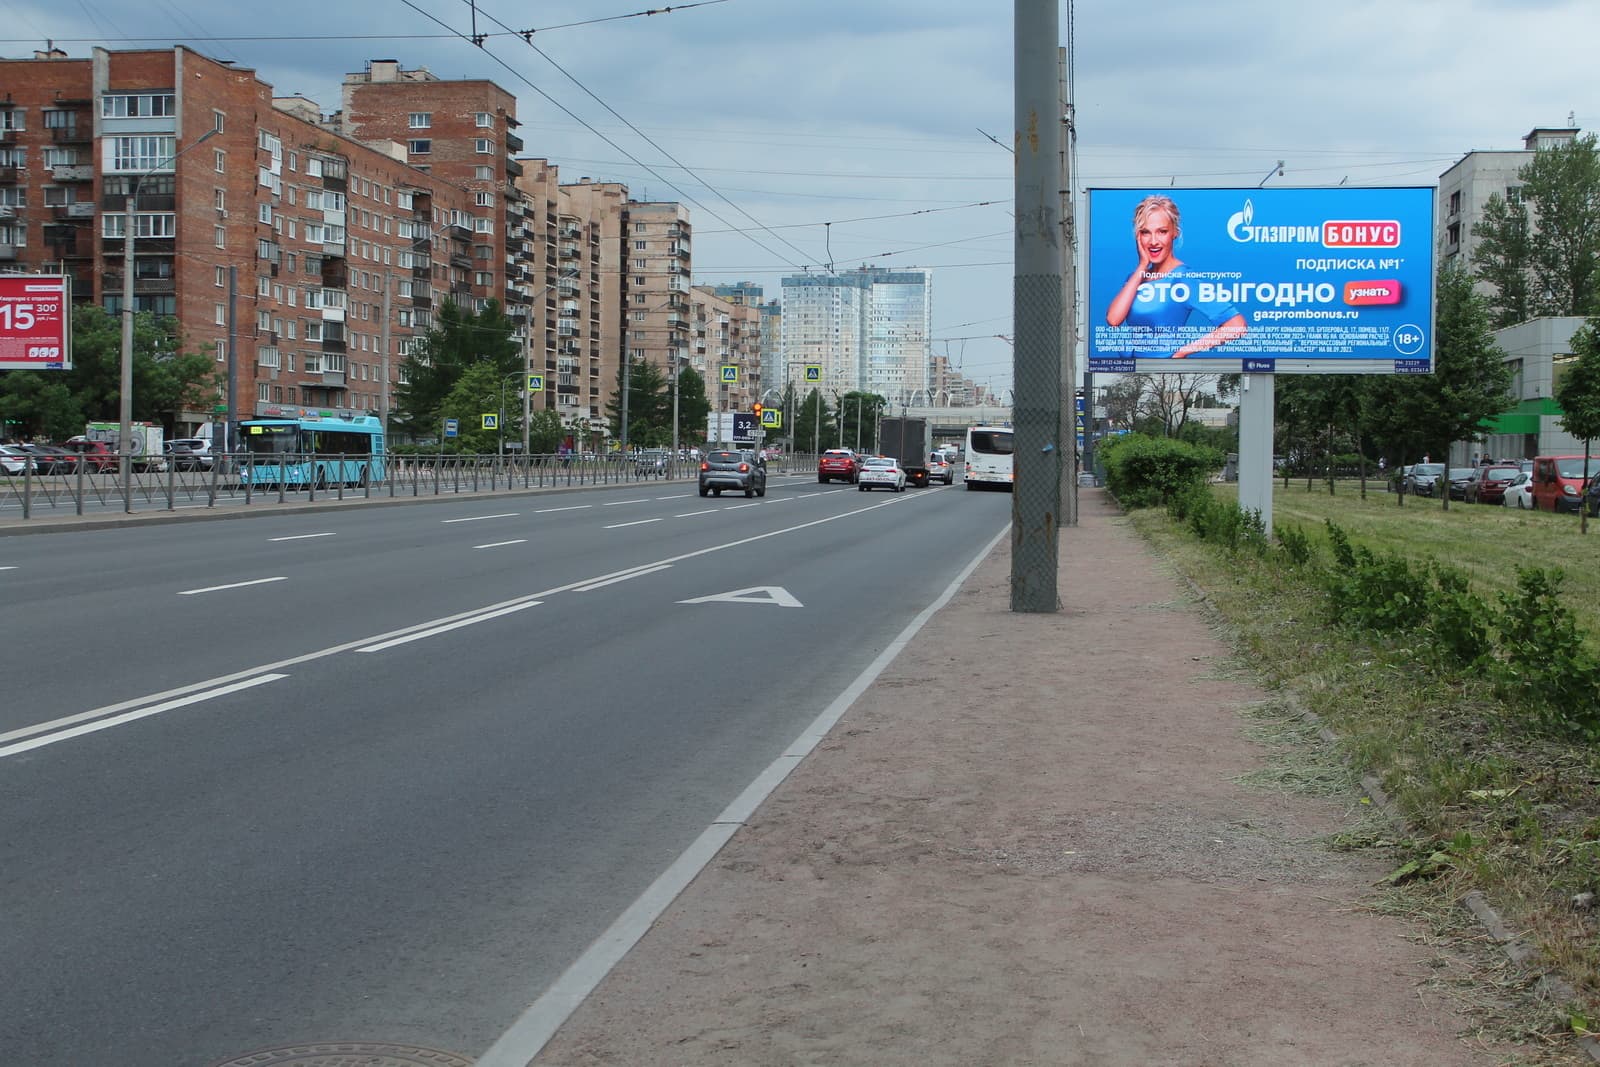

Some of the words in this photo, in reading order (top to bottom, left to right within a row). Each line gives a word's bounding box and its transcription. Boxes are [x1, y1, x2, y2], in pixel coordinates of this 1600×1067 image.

[1255, 226, 1319, 243] ГАЗПРОМ
[1327, 226, 1394, 243] БОНУС
[1296, 259, 1375, 272] ПОДПИСКА
[1139, 271, 1242, 280] Подписка-конструктор
[1137, 283, 1190, 302] ЭТО
[1198, 283, 1335, 306] ВЫГОДНО
[1350, 288, 1390, 300] узнать
[0, 304, 35, 330] 15
[1253, 309, 1359, 321] gazprombonus.ru
[1398, 332, 1420, 344] 18+
